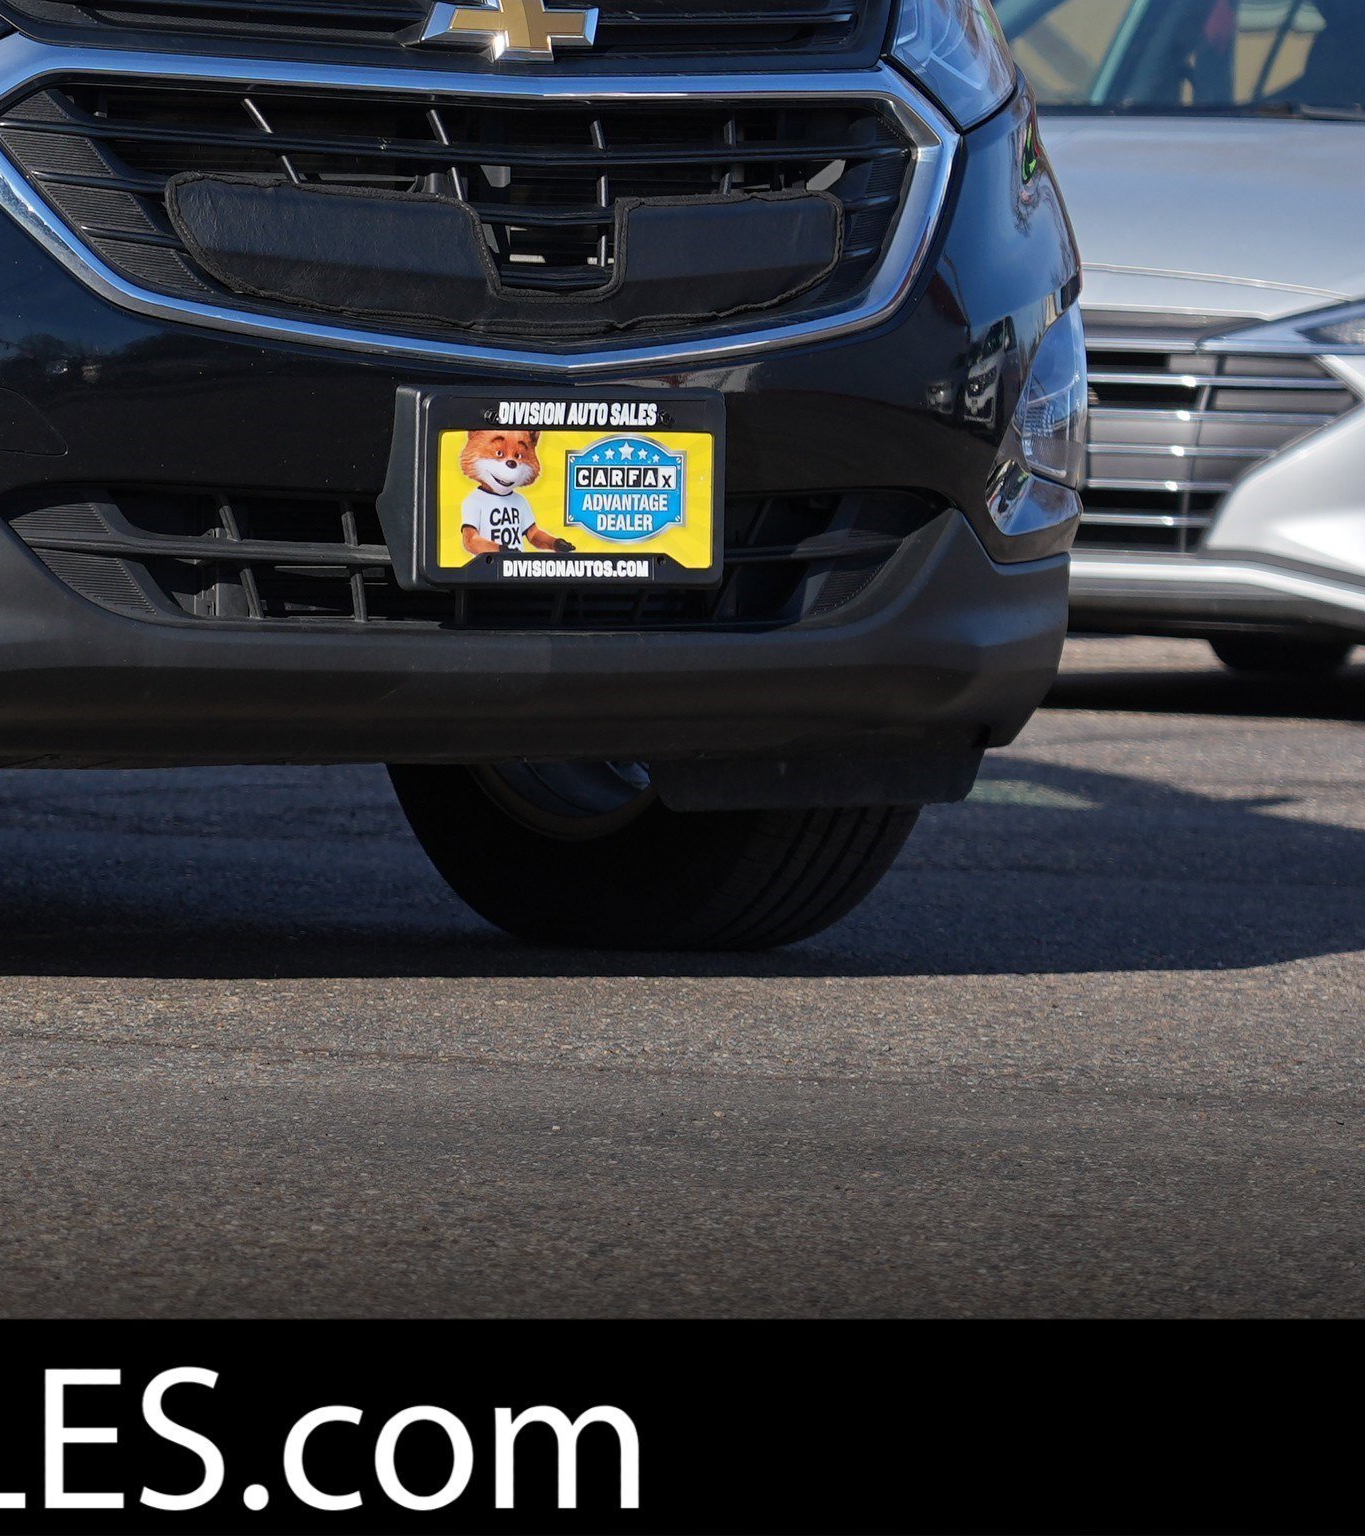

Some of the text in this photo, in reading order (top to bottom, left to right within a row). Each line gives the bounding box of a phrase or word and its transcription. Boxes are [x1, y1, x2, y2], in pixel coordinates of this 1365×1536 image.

[497, 400, 658, 427] DIVISION AUTO SALES
[575, 466, 677, 490] CARFAX
[581, 493, 669, 513] ADVANTAGE
[488, 507, 521, 526] CAR
[596, 513, 654, 533] DEALER
[490, 527, 522, 546] FOX
[501, 559, 650, 579] DIVISIONAUTOS.COM
